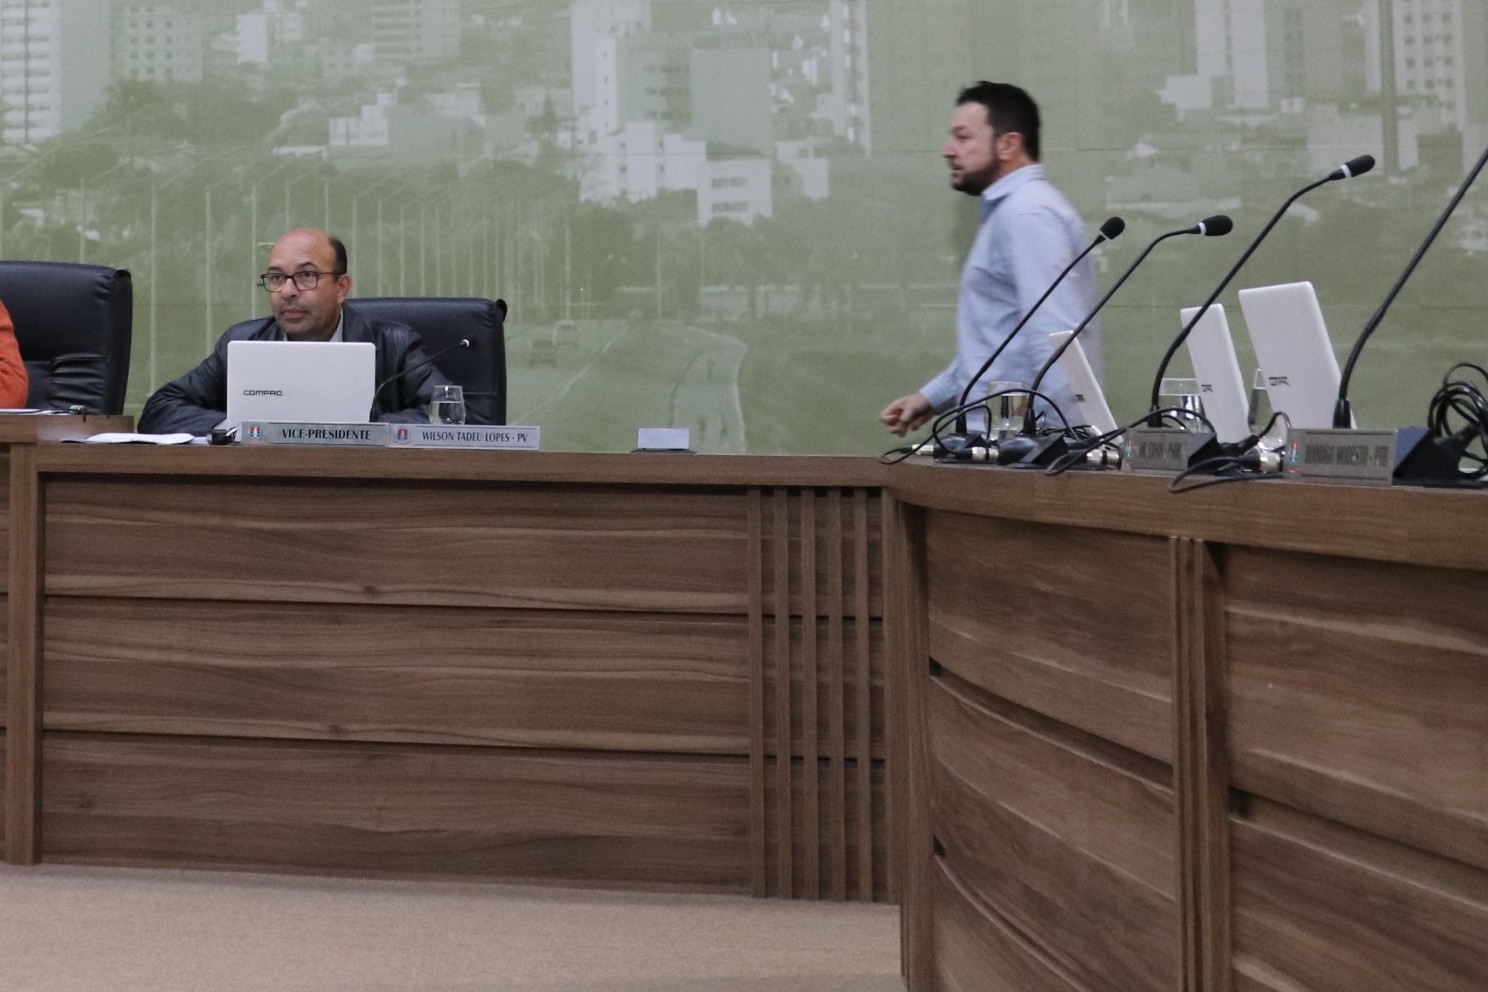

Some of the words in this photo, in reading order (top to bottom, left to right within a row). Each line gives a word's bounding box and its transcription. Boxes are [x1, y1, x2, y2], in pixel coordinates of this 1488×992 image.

[243, 389, 283, 397] COMPAQ
[281, 428, 371, 441] VICE-PRESIDENTE
[422, 431, 455, 443] WILSON
[457, 431, 483, 443] TADEU
[485, 432, 510, 443] LOPES
[517, 432, 528, 444] PV
